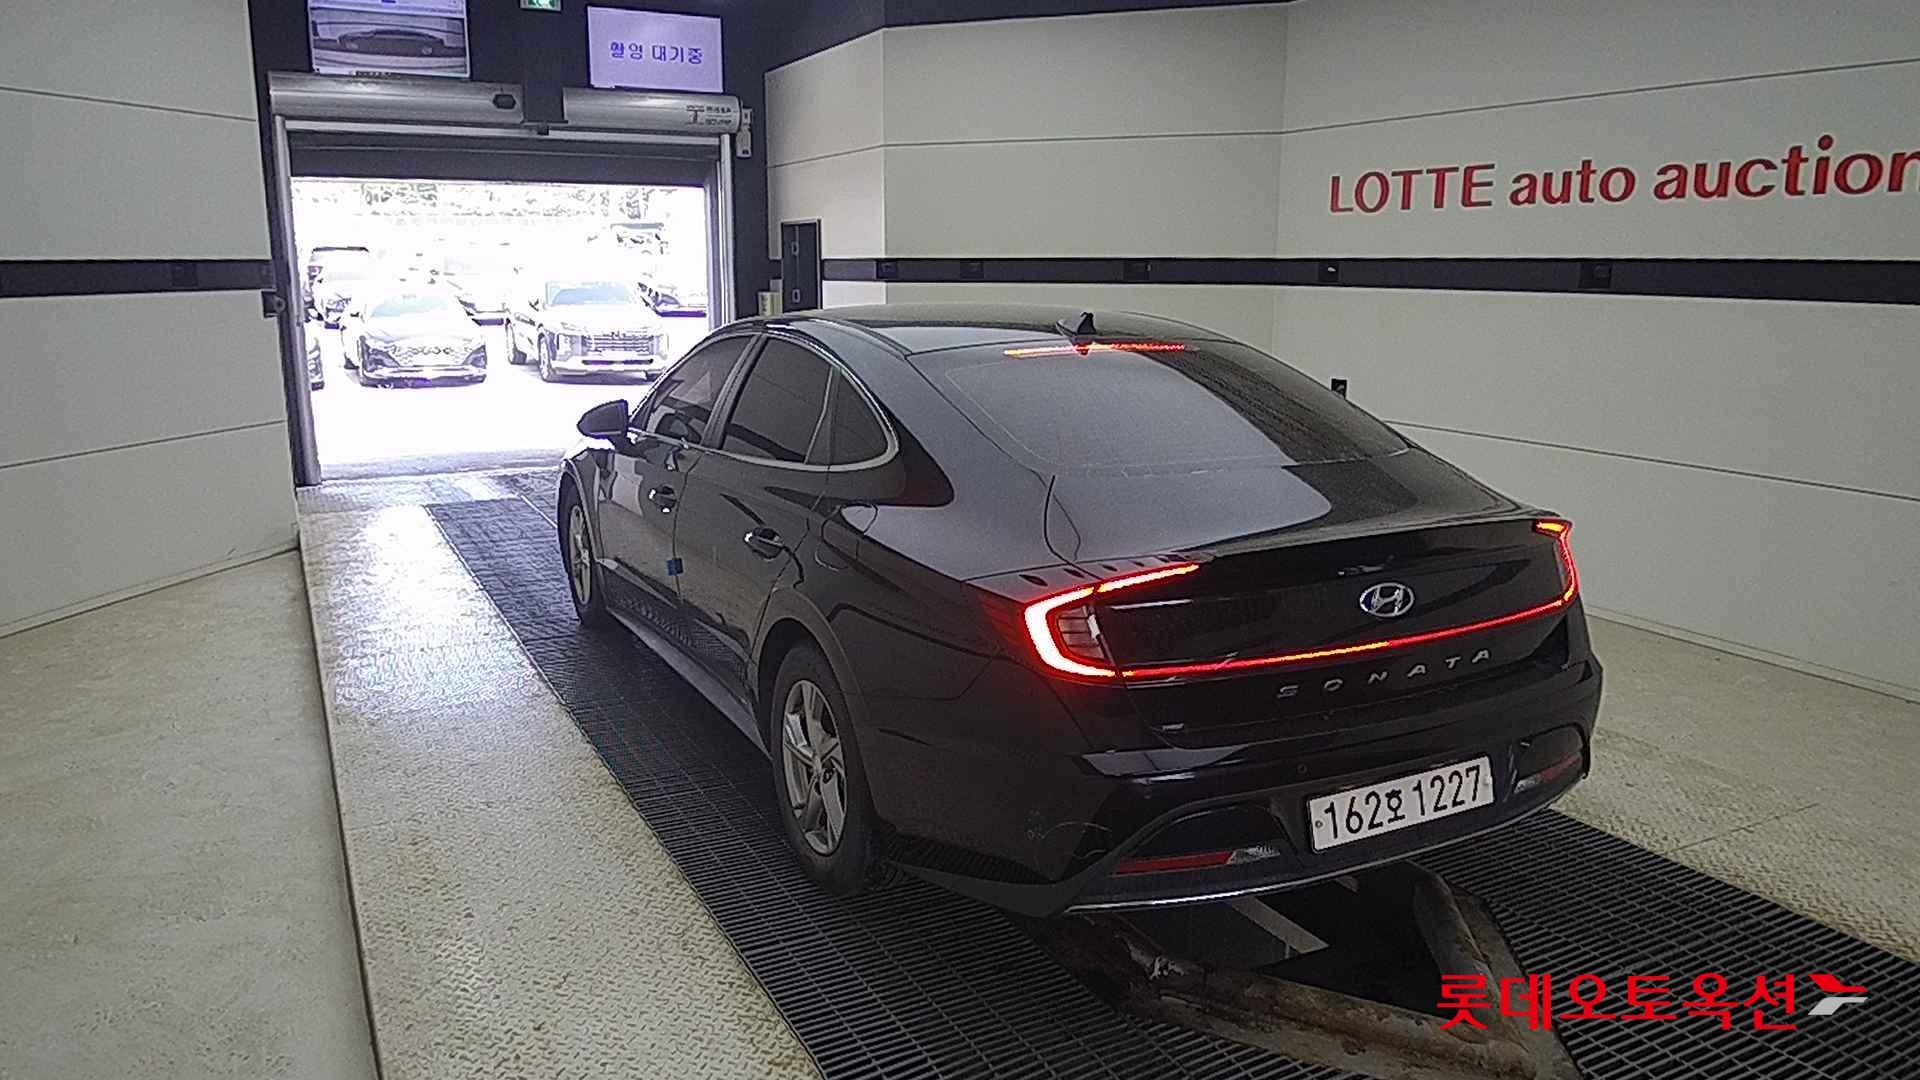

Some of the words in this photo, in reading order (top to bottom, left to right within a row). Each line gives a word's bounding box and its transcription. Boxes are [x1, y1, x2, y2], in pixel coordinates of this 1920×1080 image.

[652, 44, 703, 64] 대기중
[1330, 163, 1495, 213] LOTTE
[1510, 159, 1636, 206] auto
[1277, 648, 1492, 699] SONATA
